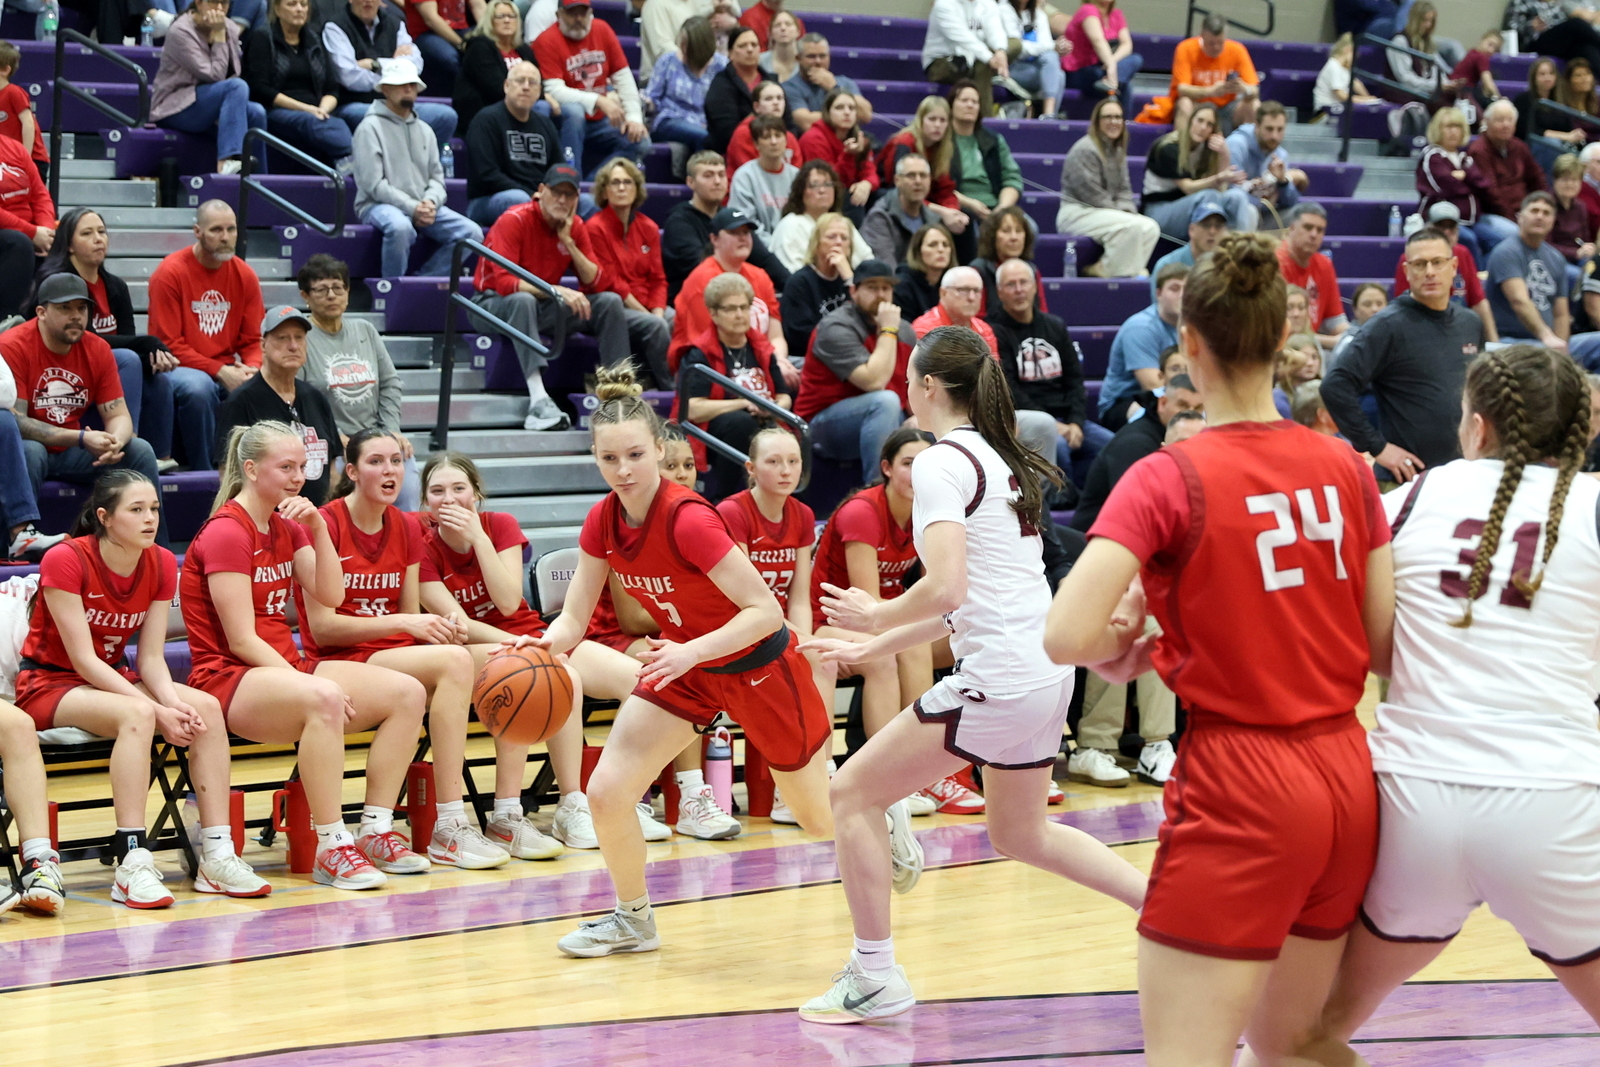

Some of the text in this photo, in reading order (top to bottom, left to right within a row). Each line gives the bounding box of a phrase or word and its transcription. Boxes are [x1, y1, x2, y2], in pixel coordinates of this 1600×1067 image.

[343, 571, 400, 590] BELLEVUE
[1245, 485, 1348, 592] 24
[1440, 517, 1541, 609] 31
